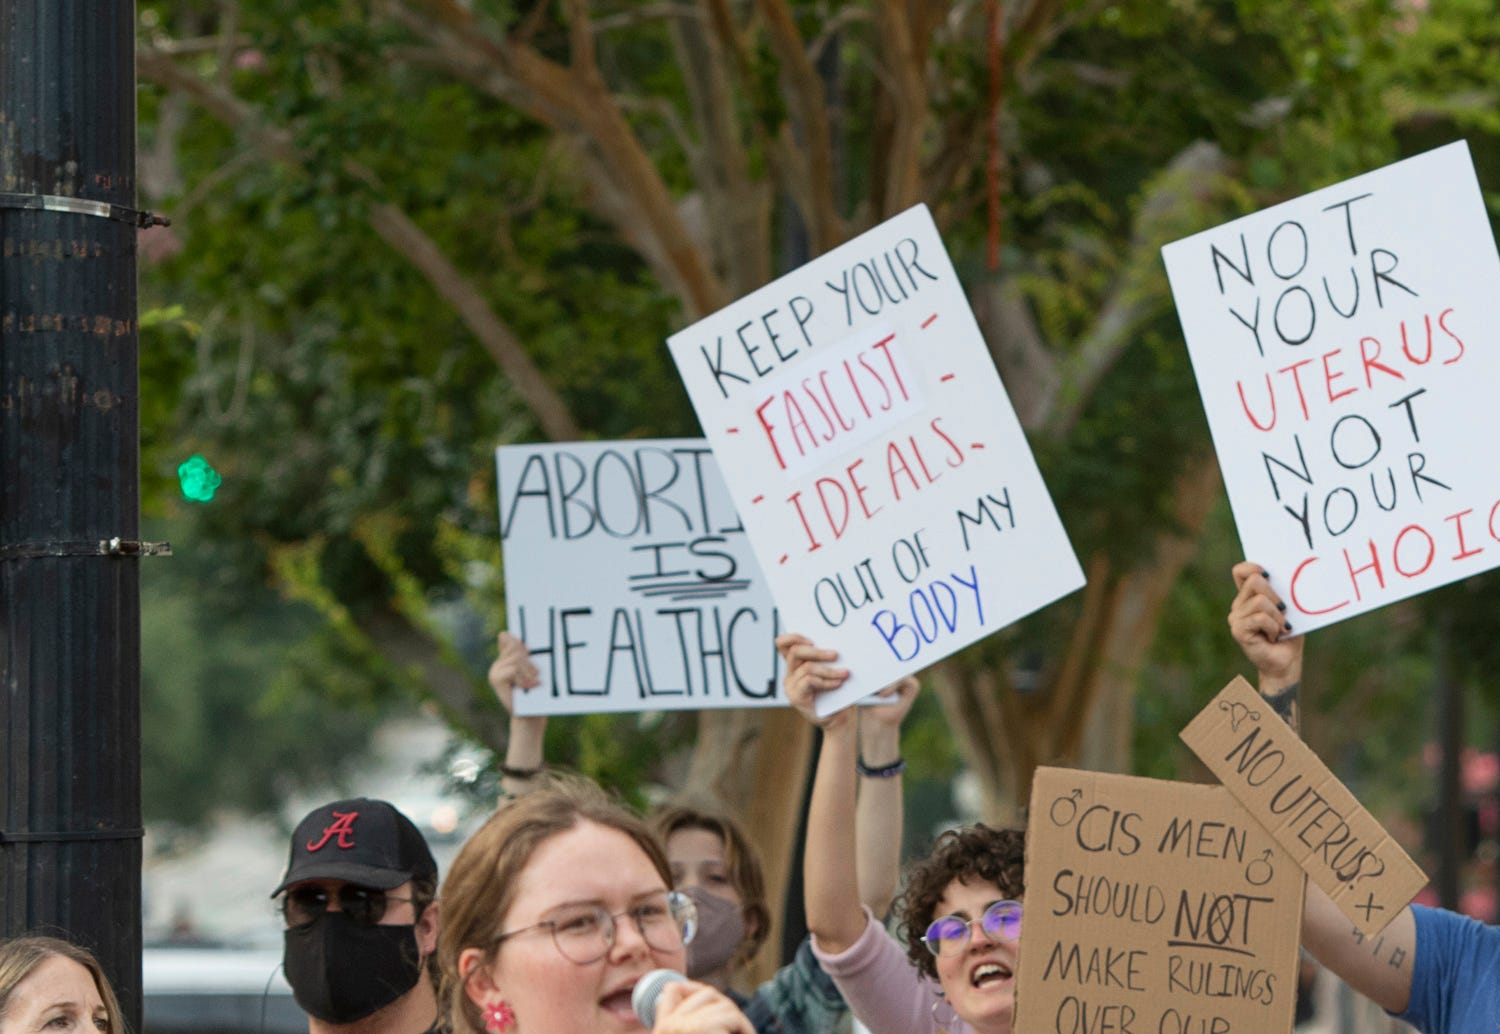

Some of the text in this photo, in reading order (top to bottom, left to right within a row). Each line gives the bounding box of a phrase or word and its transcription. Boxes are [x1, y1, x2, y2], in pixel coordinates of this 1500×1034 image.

[1212, 193, 1373, 293] NOT
[701, 238, 938, 398] KEEP YOUR
[1230, 249, 1419, 356] YOUR
[756, 334, 910, 470] FASCIST
[1238, 308, 1464, 431] UTERUS
[503, 448, 743, 540] ABORT
[788, 418, 964, 552] IDEALS
[1262, 388, 1426, 500] NOT
[1285, 452, 1452, 549] YOUR
[629, 537, 737, 581] IS
[815, 487, 1015, 627] OUT OF MY
[518, 607, 779, 699] HEALTHC
[871, 565, 984, 662] BODY
[1076, 805, 1247, 863] CIS MEN
[1225, 726, 1385, 890] NO UTERUS?
[1053, 869, 1274, 947] SHOULD NOT
[1043, 941, 1277, 1006] MAKE RULINGS
